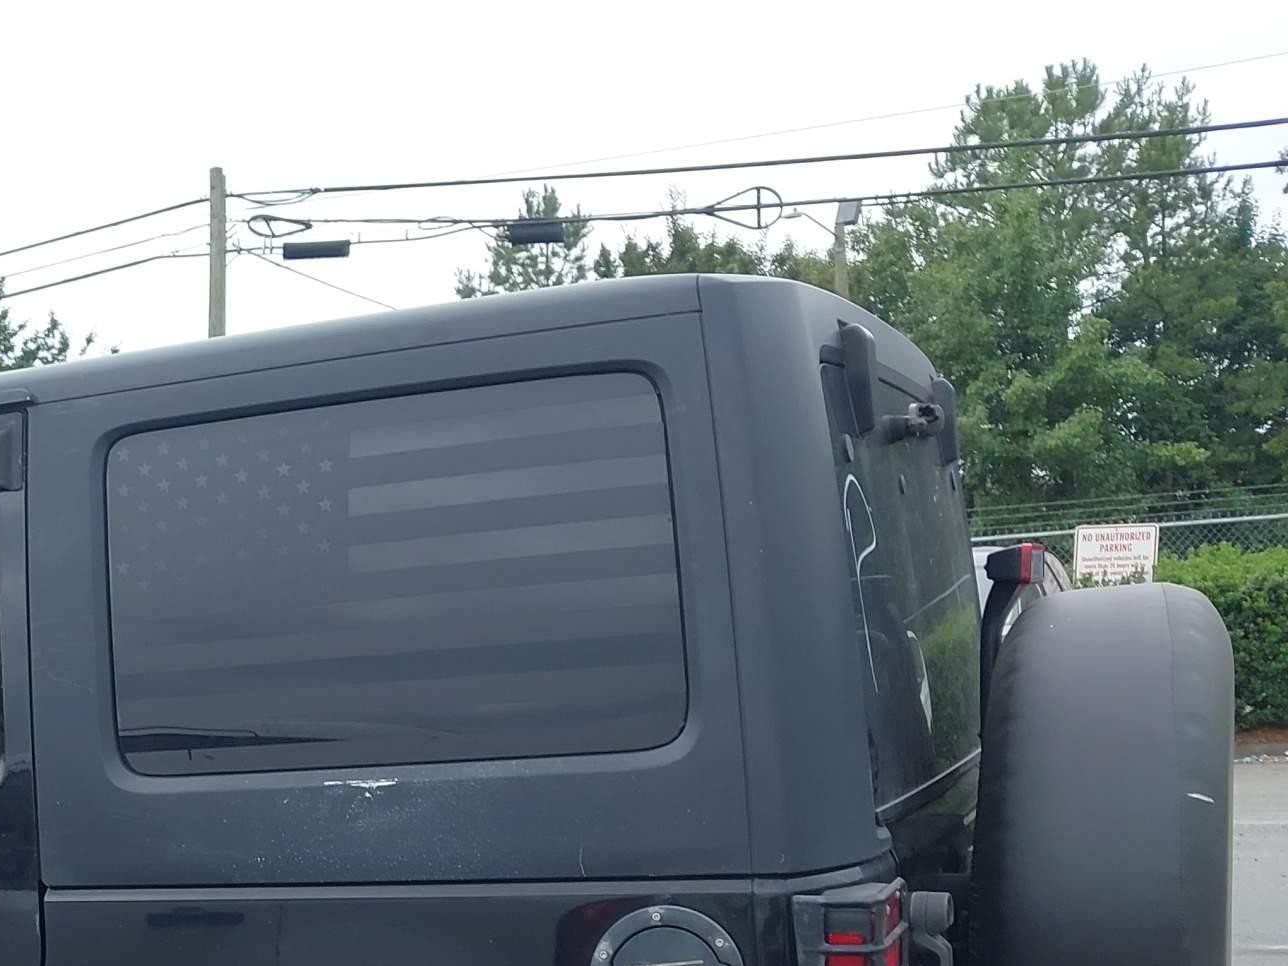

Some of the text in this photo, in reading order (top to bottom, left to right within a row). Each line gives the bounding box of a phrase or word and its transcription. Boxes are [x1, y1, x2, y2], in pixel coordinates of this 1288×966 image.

[1082, 532, 1151, 542] NO UNAUTHORIZED
[1100, 543, 1132, 552] PARKING
